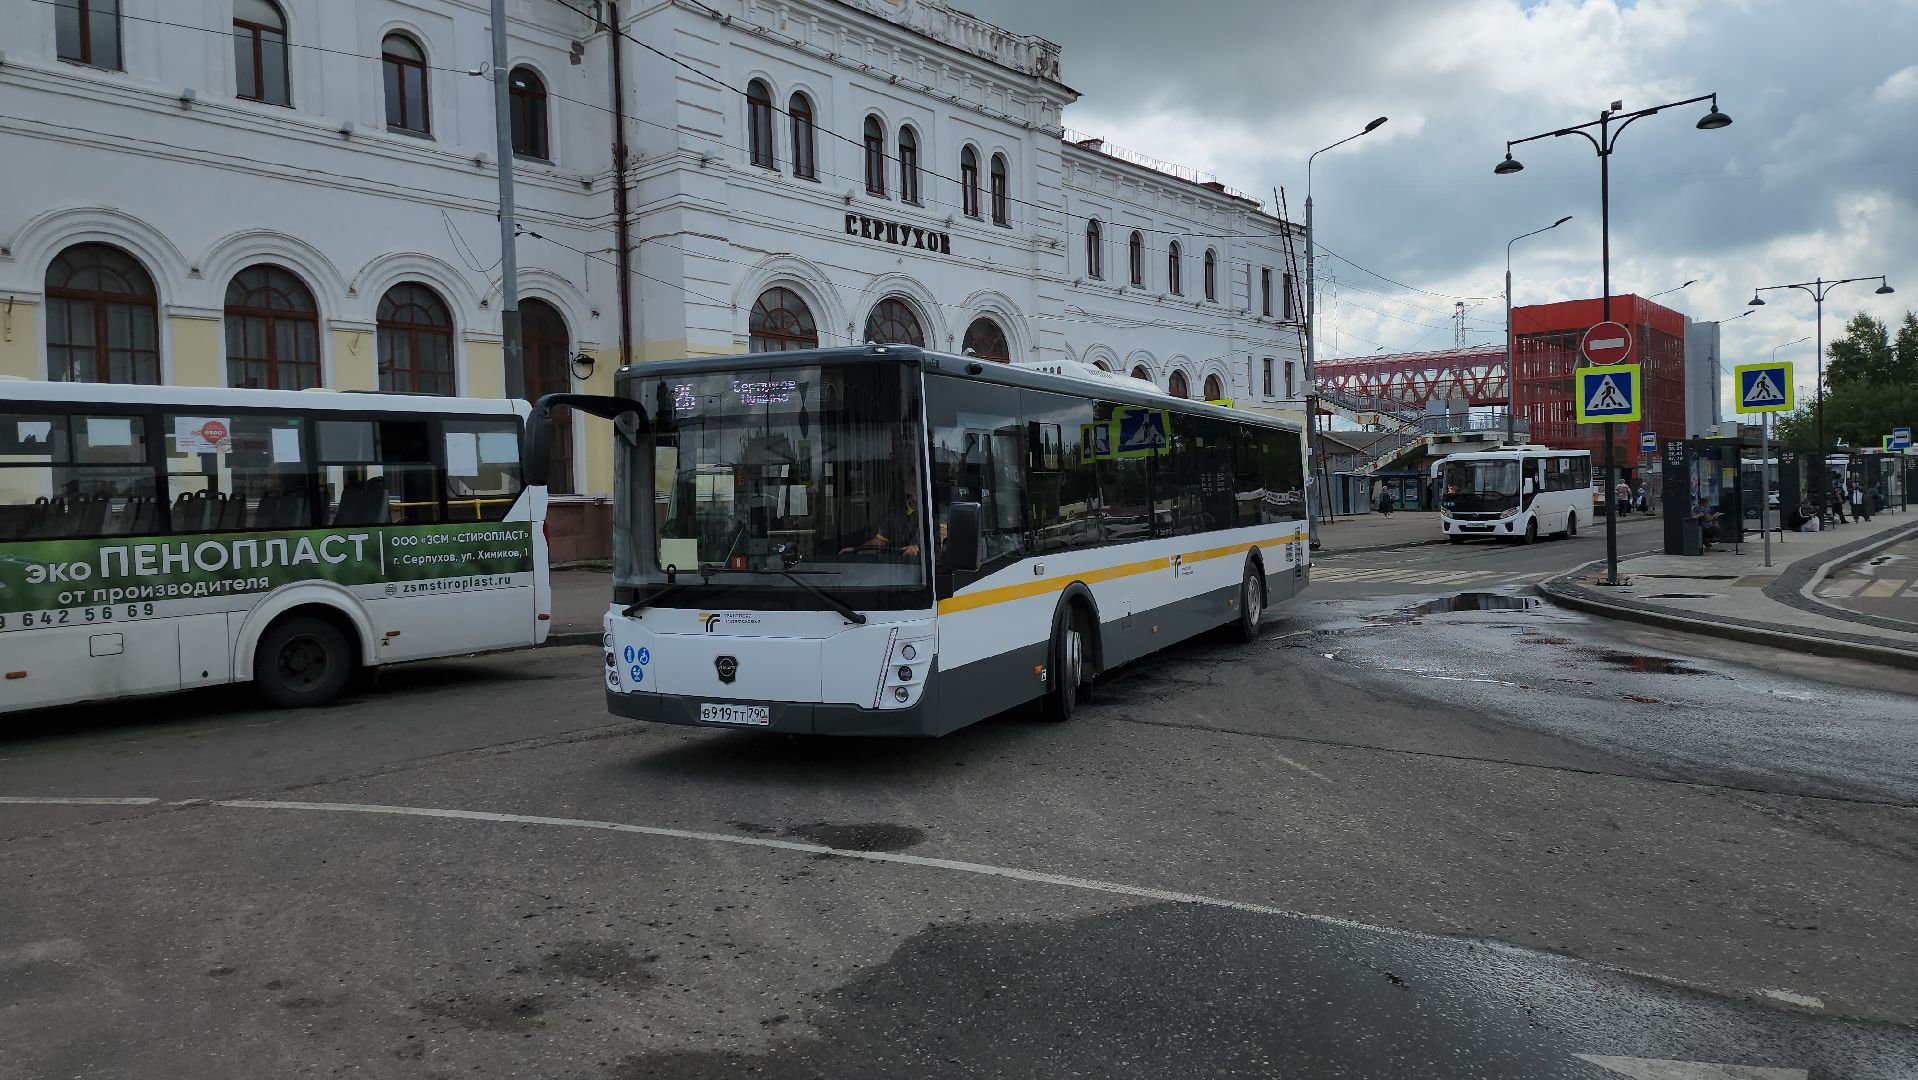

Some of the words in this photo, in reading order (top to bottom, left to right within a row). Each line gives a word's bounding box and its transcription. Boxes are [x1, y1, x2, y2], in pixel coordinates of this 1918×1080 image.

[391, 535, 418, 547] ООО
[25, 561, 92, 585] эко
[99, 532, 370, 580] ПЕНОПЛАСТ
[393, 557, 400, 565] г.
[402, 553, 458, 566] Серпухов,
[460, 551, 476, 562] ул.
[478, 547, 522, 561] Химиков,
[524, 547, 528, 557] 1
[57, 590, 86, 605] от
[93, 576, 269, 605] производителя
[402, 575, 511, 593] zsmstiroplast.ru
